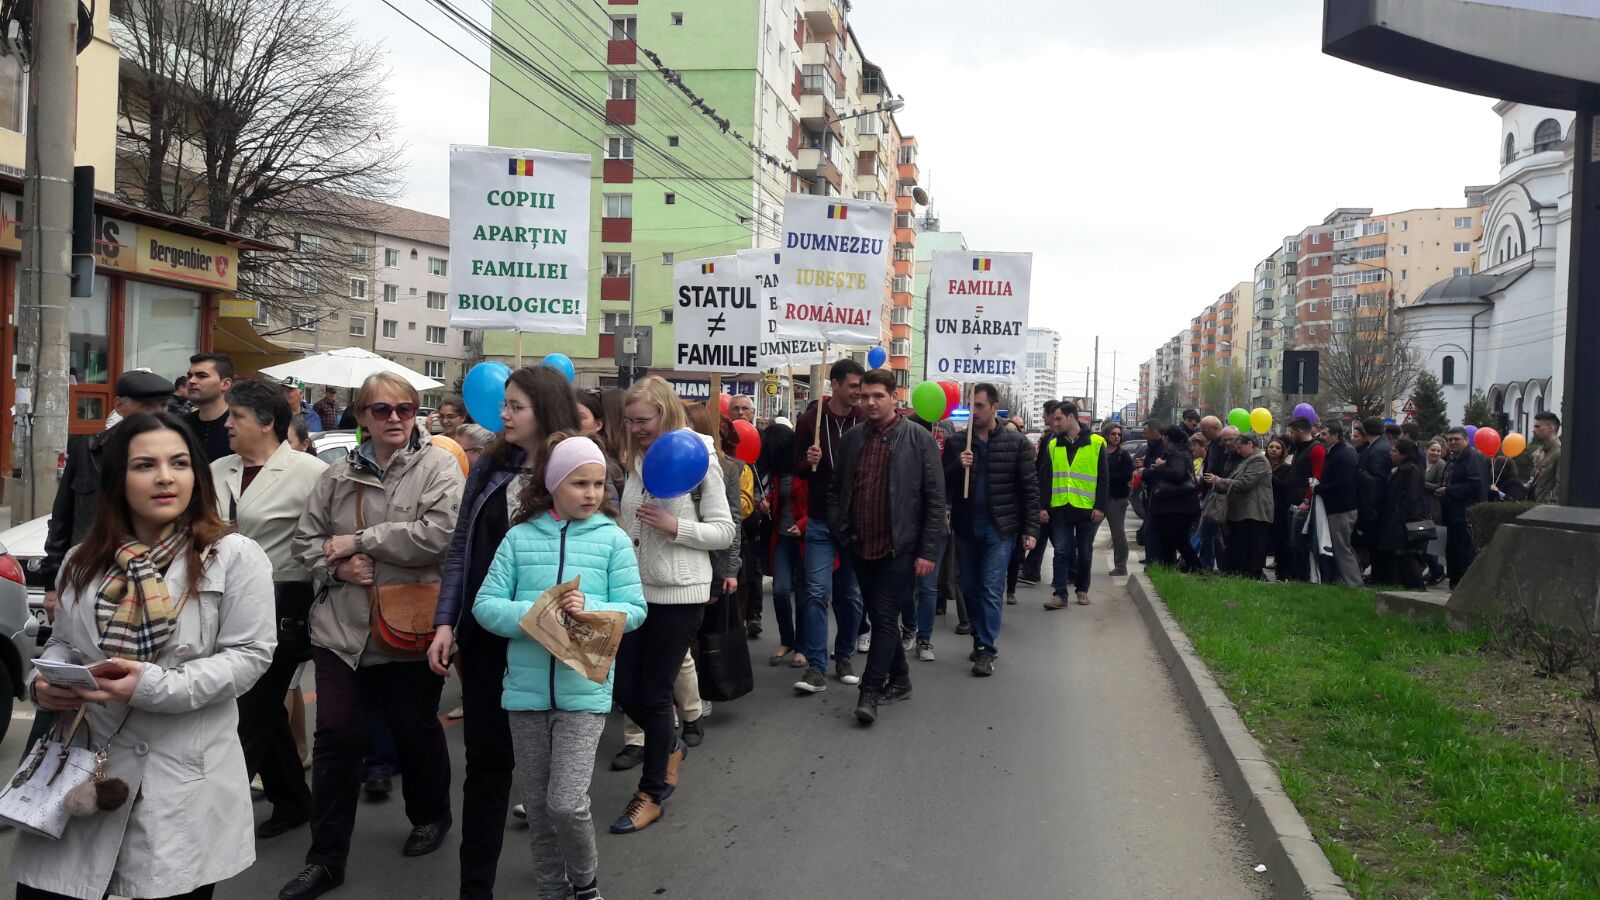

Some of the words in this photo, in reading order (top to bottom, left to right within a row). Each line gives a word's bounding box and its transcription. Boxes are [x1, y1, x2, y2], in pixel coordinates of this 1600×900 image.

[487, 190, 555, 209] COPIII
[473, 225, 567, 249] APARȚIN
[787, 232, 883, 255] DUMNEZEU
[150, 239, 212, 272] Bergenbier
[472, 260, 568, 279] FAMILIEI
[796, 268, 867, 293] IUBEȘTE
[679, 285, 757, 309] STATUL
[948, 280, 1013, 296] FAMILIA
[458, 294, 580, 315] BIOLOGICE!
[785, 302, 871, 326] ROMÂNIA!
[936, 319, 958, 334] UN
[961, 315, 1022, 336] BĂRBAT
[678, 343, 757, 367] FAMILIE
[938, 358, 949, 372] O
[953, 358, 1016, 375] FEMEIE!
